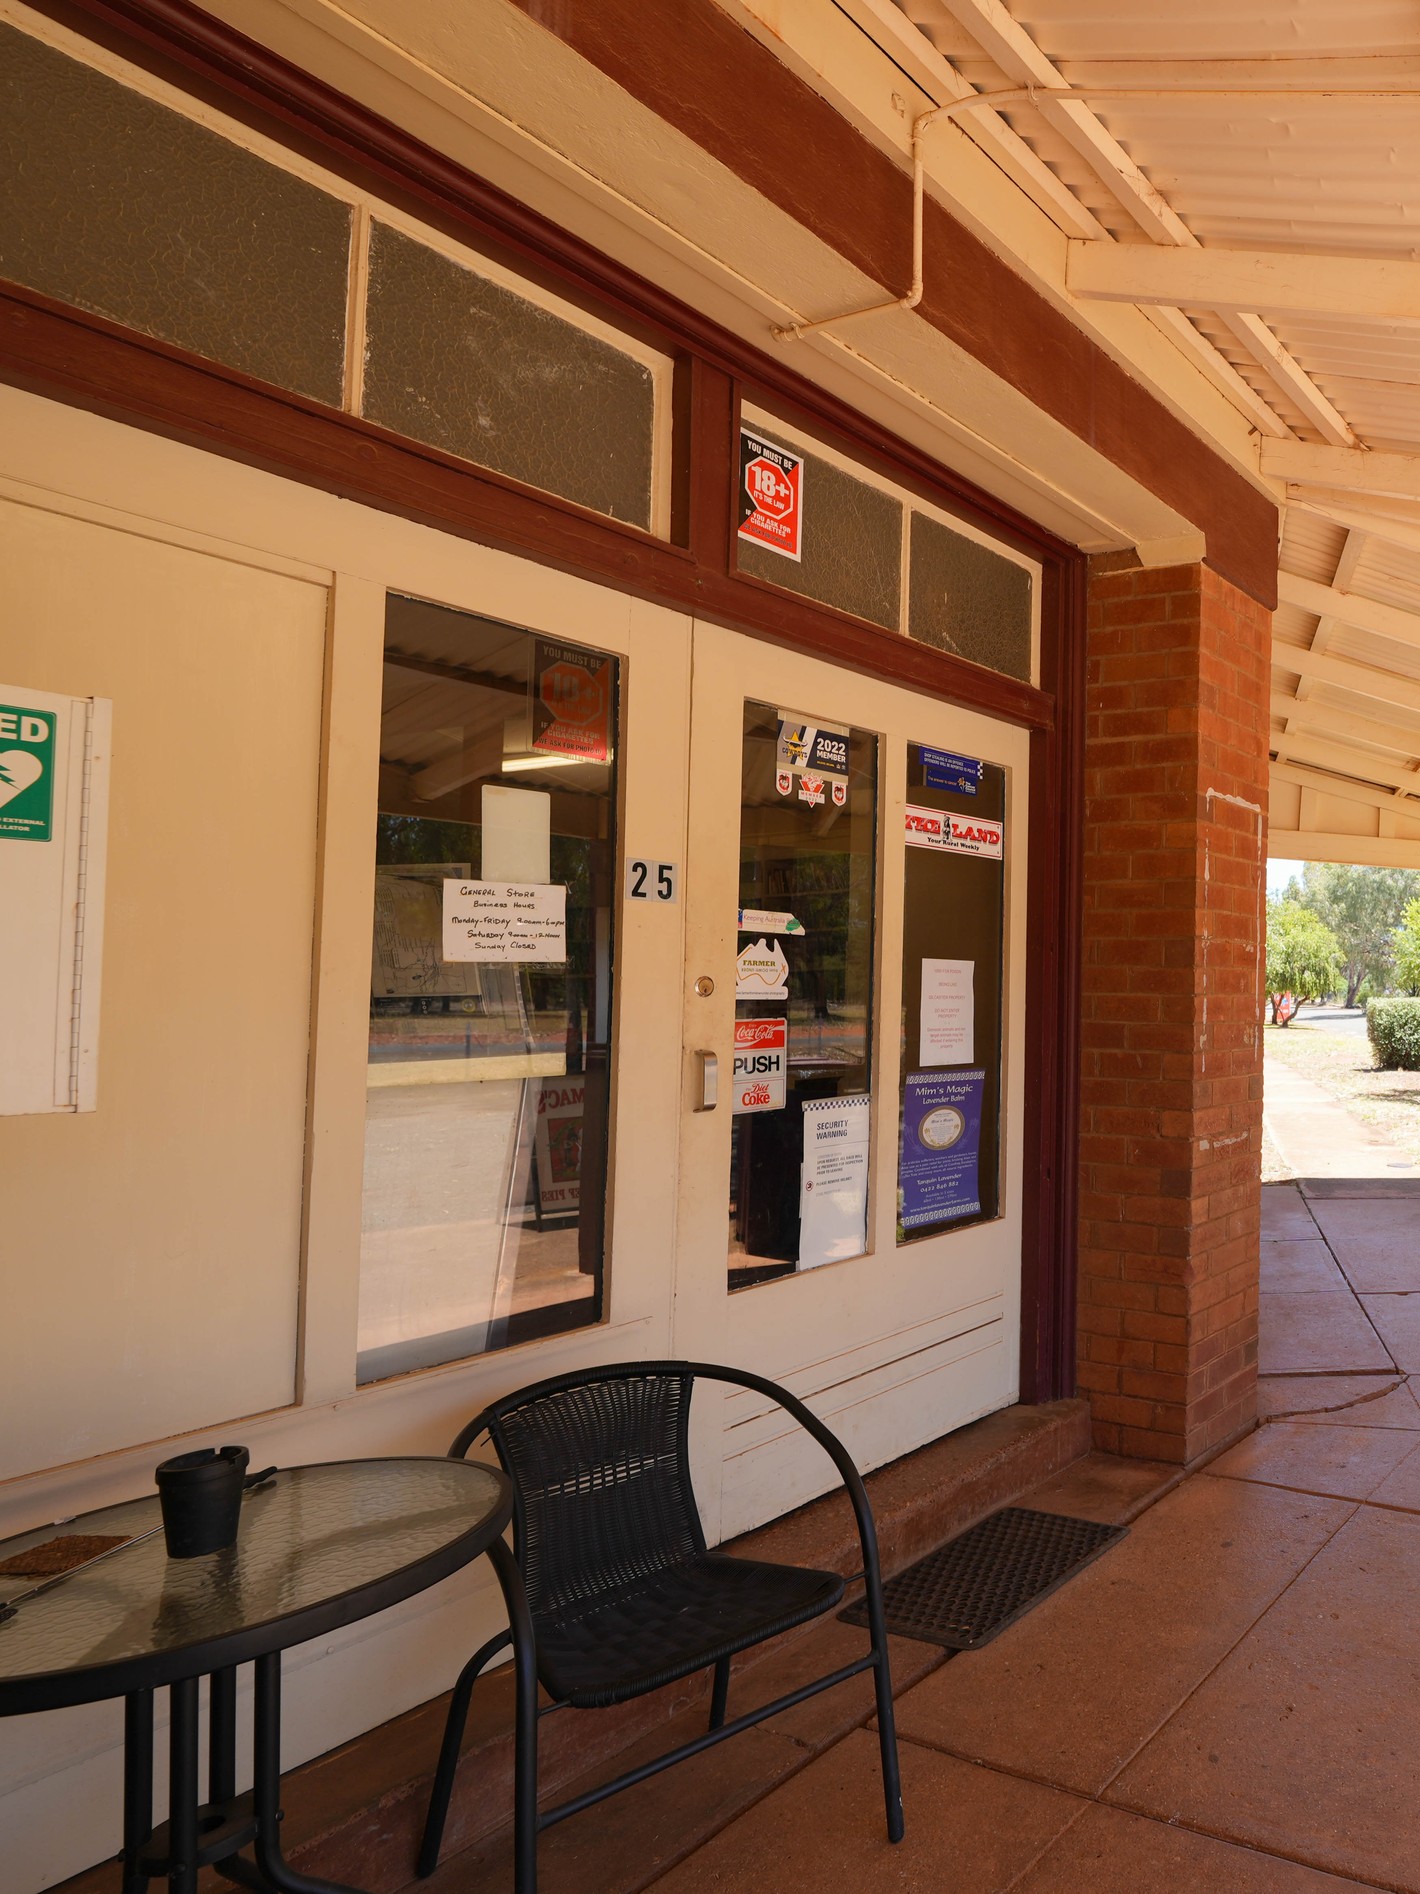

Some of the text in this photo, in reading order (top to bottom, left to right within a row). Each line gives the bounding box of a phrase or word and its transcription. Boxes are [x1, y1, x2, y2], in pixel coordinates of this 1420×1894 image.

[747, 440, 793, 471] YOU MUST BE
[751, 465, 790, 497] 18+
[753, 490, 785, 511] IT'S THE LAW
[745, 508, 791, 534] IF YOU ASK FOR
[750, 517, 787, 538] CIGARETTES
[543, 645, 602, 670] YOU MUST BE
[816, 737, 846, 756] 2022
[816, 750, 846, 763] MEMBER
[3, 817, 46, 826] EXTERNAL
[905, 814, 1000, 845] THE LAND
[942, 839, 959, 848] Rural
[960, 842, 979, 852] Weekly
[631, 861, 673, 900] 25
[743, 914, 763, 923] Keeping
[765, 915, 786, 924] Australia
[742, 959, 776, 967] FARMER
[736, 1024, 775, 1040] Coca-Cola
[733, 1055, 780, 1076] PUSH
[751, 1083, 769, 1094] Diet
[915, 1084, 974, 1097] Mim's Magic
[741, 1091, 770, 1107] Coke
[922, 1097, 950, 1105] Lavender
[816, 1120, 849, 1131] SECURITY
[816, 1129, 848, 1140] WARNING
[938, 1173, 962, 1182] Lavender
[920, 1185, 935, 1193] 0422
